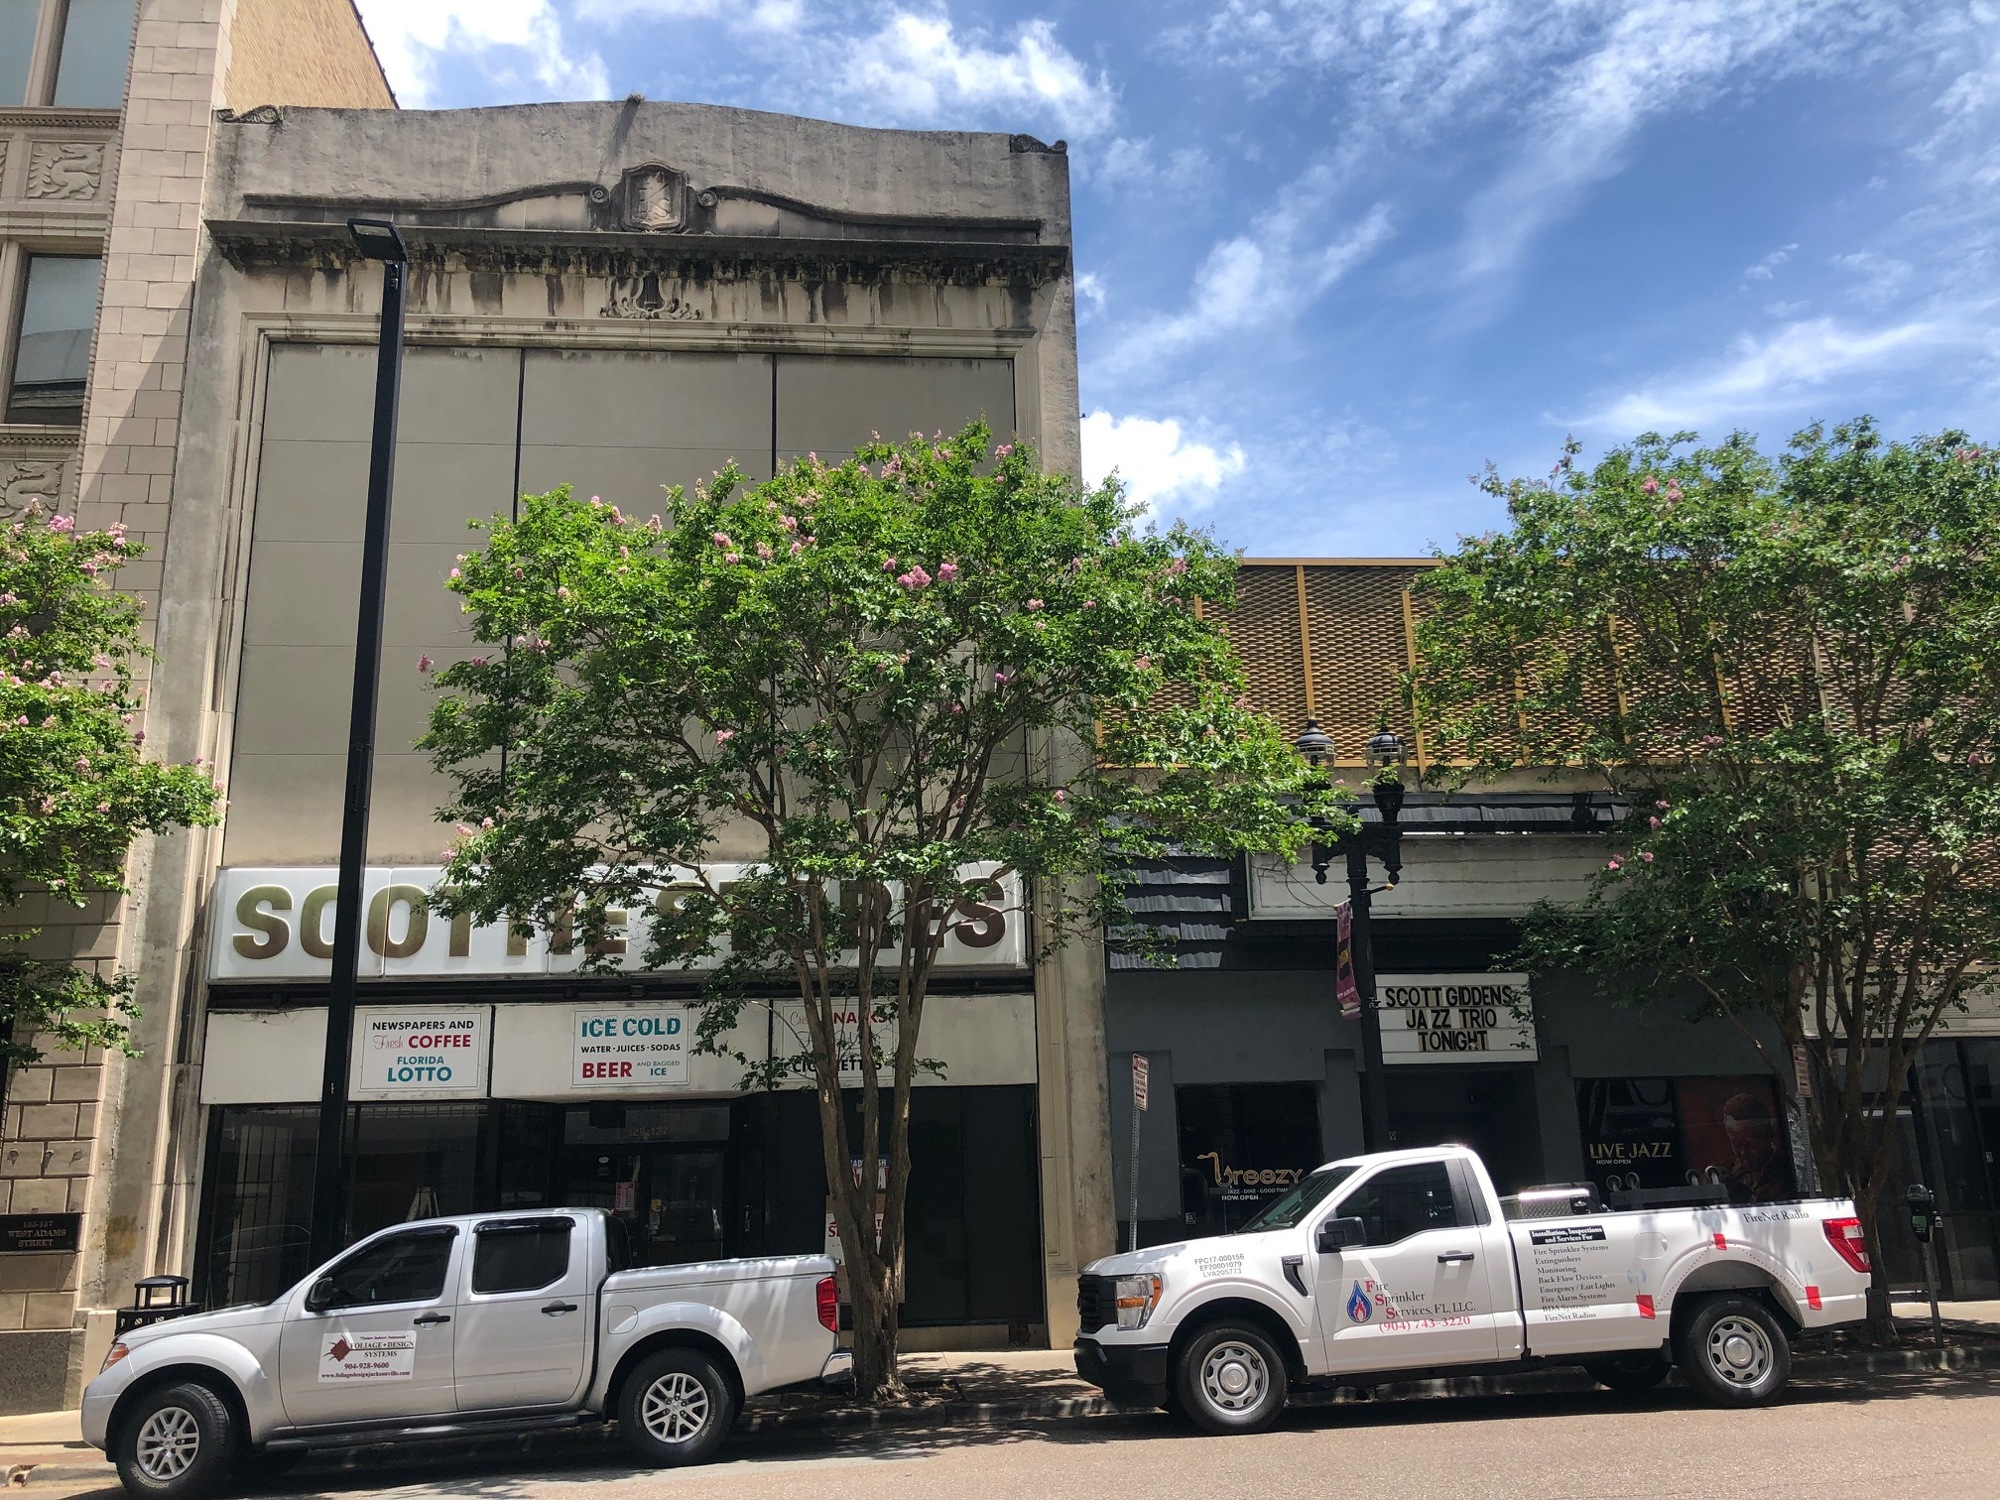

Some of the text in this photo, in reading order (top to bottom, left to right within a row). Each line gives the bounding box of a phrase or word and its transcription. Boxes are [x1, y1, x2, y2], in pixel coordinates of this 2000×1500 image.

[655, 877, 1006, 953] STRES
[1385, 985, 1513, 1007] SCOTT GIDDENS
[823, 1010, 889, 1025] NAKS
[1406, 1008, 1497, 1029] JAZZ TRIO
[372, 1020, 474, 1030] NEWSPAPERS AND
[581, 1014, 681, 1037] ICE COLD
[372, 1034, 471, 1050] Fresh COFFEE
[1417, 1030, 1488, 1051] TONIGHT
[580, 1043, 681, 1053] WATER JUICES SODAS
[397, 1056, 445, 1065] FLORIDA
[793, 1060, 882, 1073] CIGETTS
[387, 1066, 453, 1082] LOTTO
[582, 1061, 633, 1078] BEER
[650, 1068, 667, 1076] ICE
[1589, 1142, 1672, 1159] LIVE JAZZ
[1743, 1209, 1809, 1223] FireNet Radio
[8, 1229, 67, 1238] WEST ADAMS
[1531, 1226, 1602, 1238] Installation, Inspections
[18, 1239, 54, 1248] STREET
[1533, 1244, 1609, 1256] Fire Sprinkler Systems
[1535, 1256, 1582, 1265] Extinguishers
[1537, 1266, 1577, 1275] Monitoring
[1575, 1273, 1603, 1281] Devices
[1365, 1280, 1389, 1293] Fire
[1540, 1286, 1575, 1294] Emergency
[1594, 1282, 1616, 1290] Lights
[1374, 1291, 1426, 1307] Sprinkler
[1556, 1294, 1577, 1302] Alarm
[1578, 1292, 1607, 1301] Systems
[1386, 1306, 1433, 1320] Services,
[1453, 1301, 1477, 1313] LLC.
[1561, 1303, 1590, 1311] Systems
[1544, 1311, 1597, 1321] FireNet Radios
[1379, 1315, 1471, 1333] (904) 743-3220
[350, 1341, 383, 1349] FOLIAGE
[344, 1362, 390, 1370] 904-928-9600
